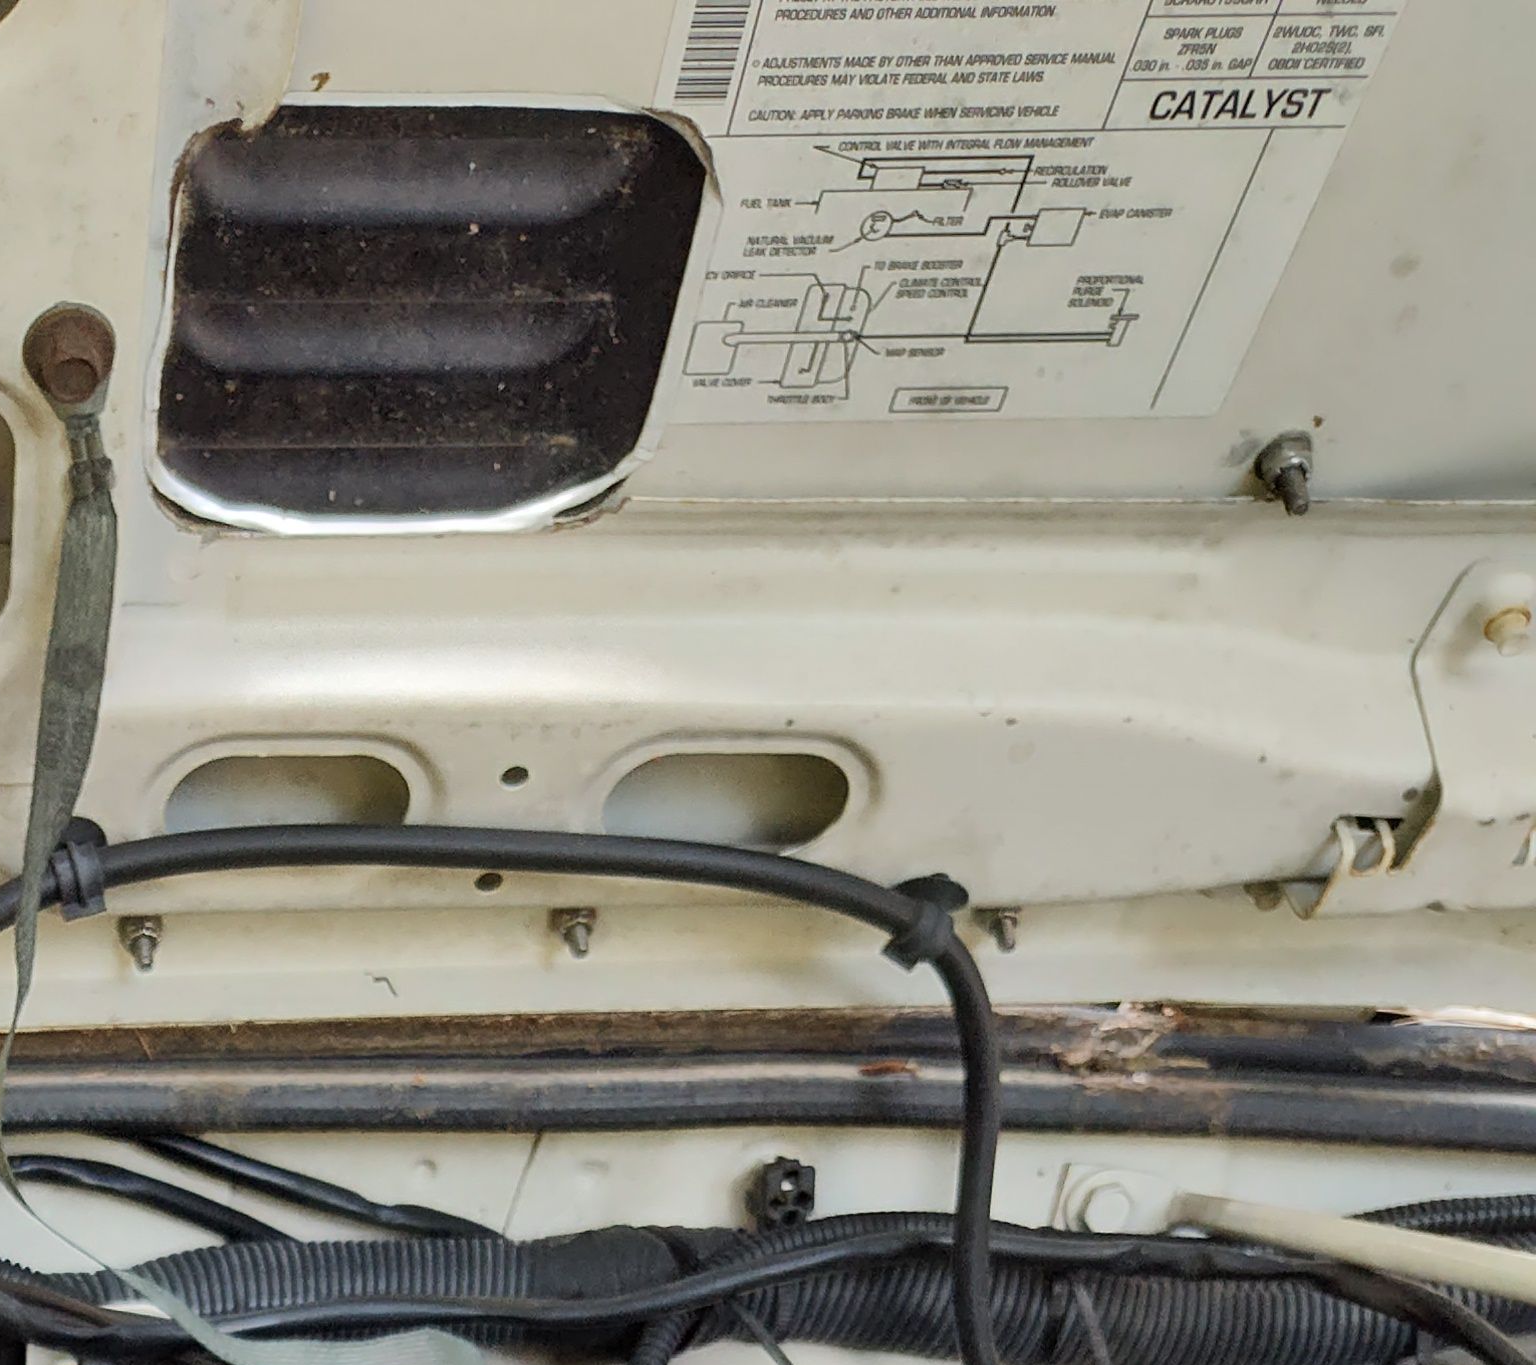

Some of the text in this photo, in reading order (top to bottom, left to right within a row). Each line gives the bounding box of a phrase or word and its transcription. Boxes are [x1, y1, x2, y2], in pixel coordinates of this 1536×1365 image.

[774, 5, 1056, 21] PROCEDURES AND OTHER ADDITIONAL INFORMATION
[1163, 26, 1244, 40] SPARK PLUGS
[761, 52, 1116, 69] ADJUSTMENTS MADE BY OTHER THAN APPROVED SERVICE MANUAL
[1227, 58, 1253, 71] GAP
[1303, 56, 1367, 70] CERTIFIED
[757, 71, 1045, 87] PROCEDURES MAY VIOLATE FEDERAL AND STATE LAWS
[1148, 87, 1333, 121] CATALYST
[748, 105, 1061, 122] CAUTION: APPLY PARKING BRAKE WHEN SERVICING VEHICLE
[838, 136, 1096, 152] CONTROL VALVE WITH INTEGRAL FLOW MANAGEMENT
[1050, 176, 1133, 188] ROLLOVER VALVE
[739, 198, 792, 209] FUEL TANK
[933, 215, 965, 227] FILTER
